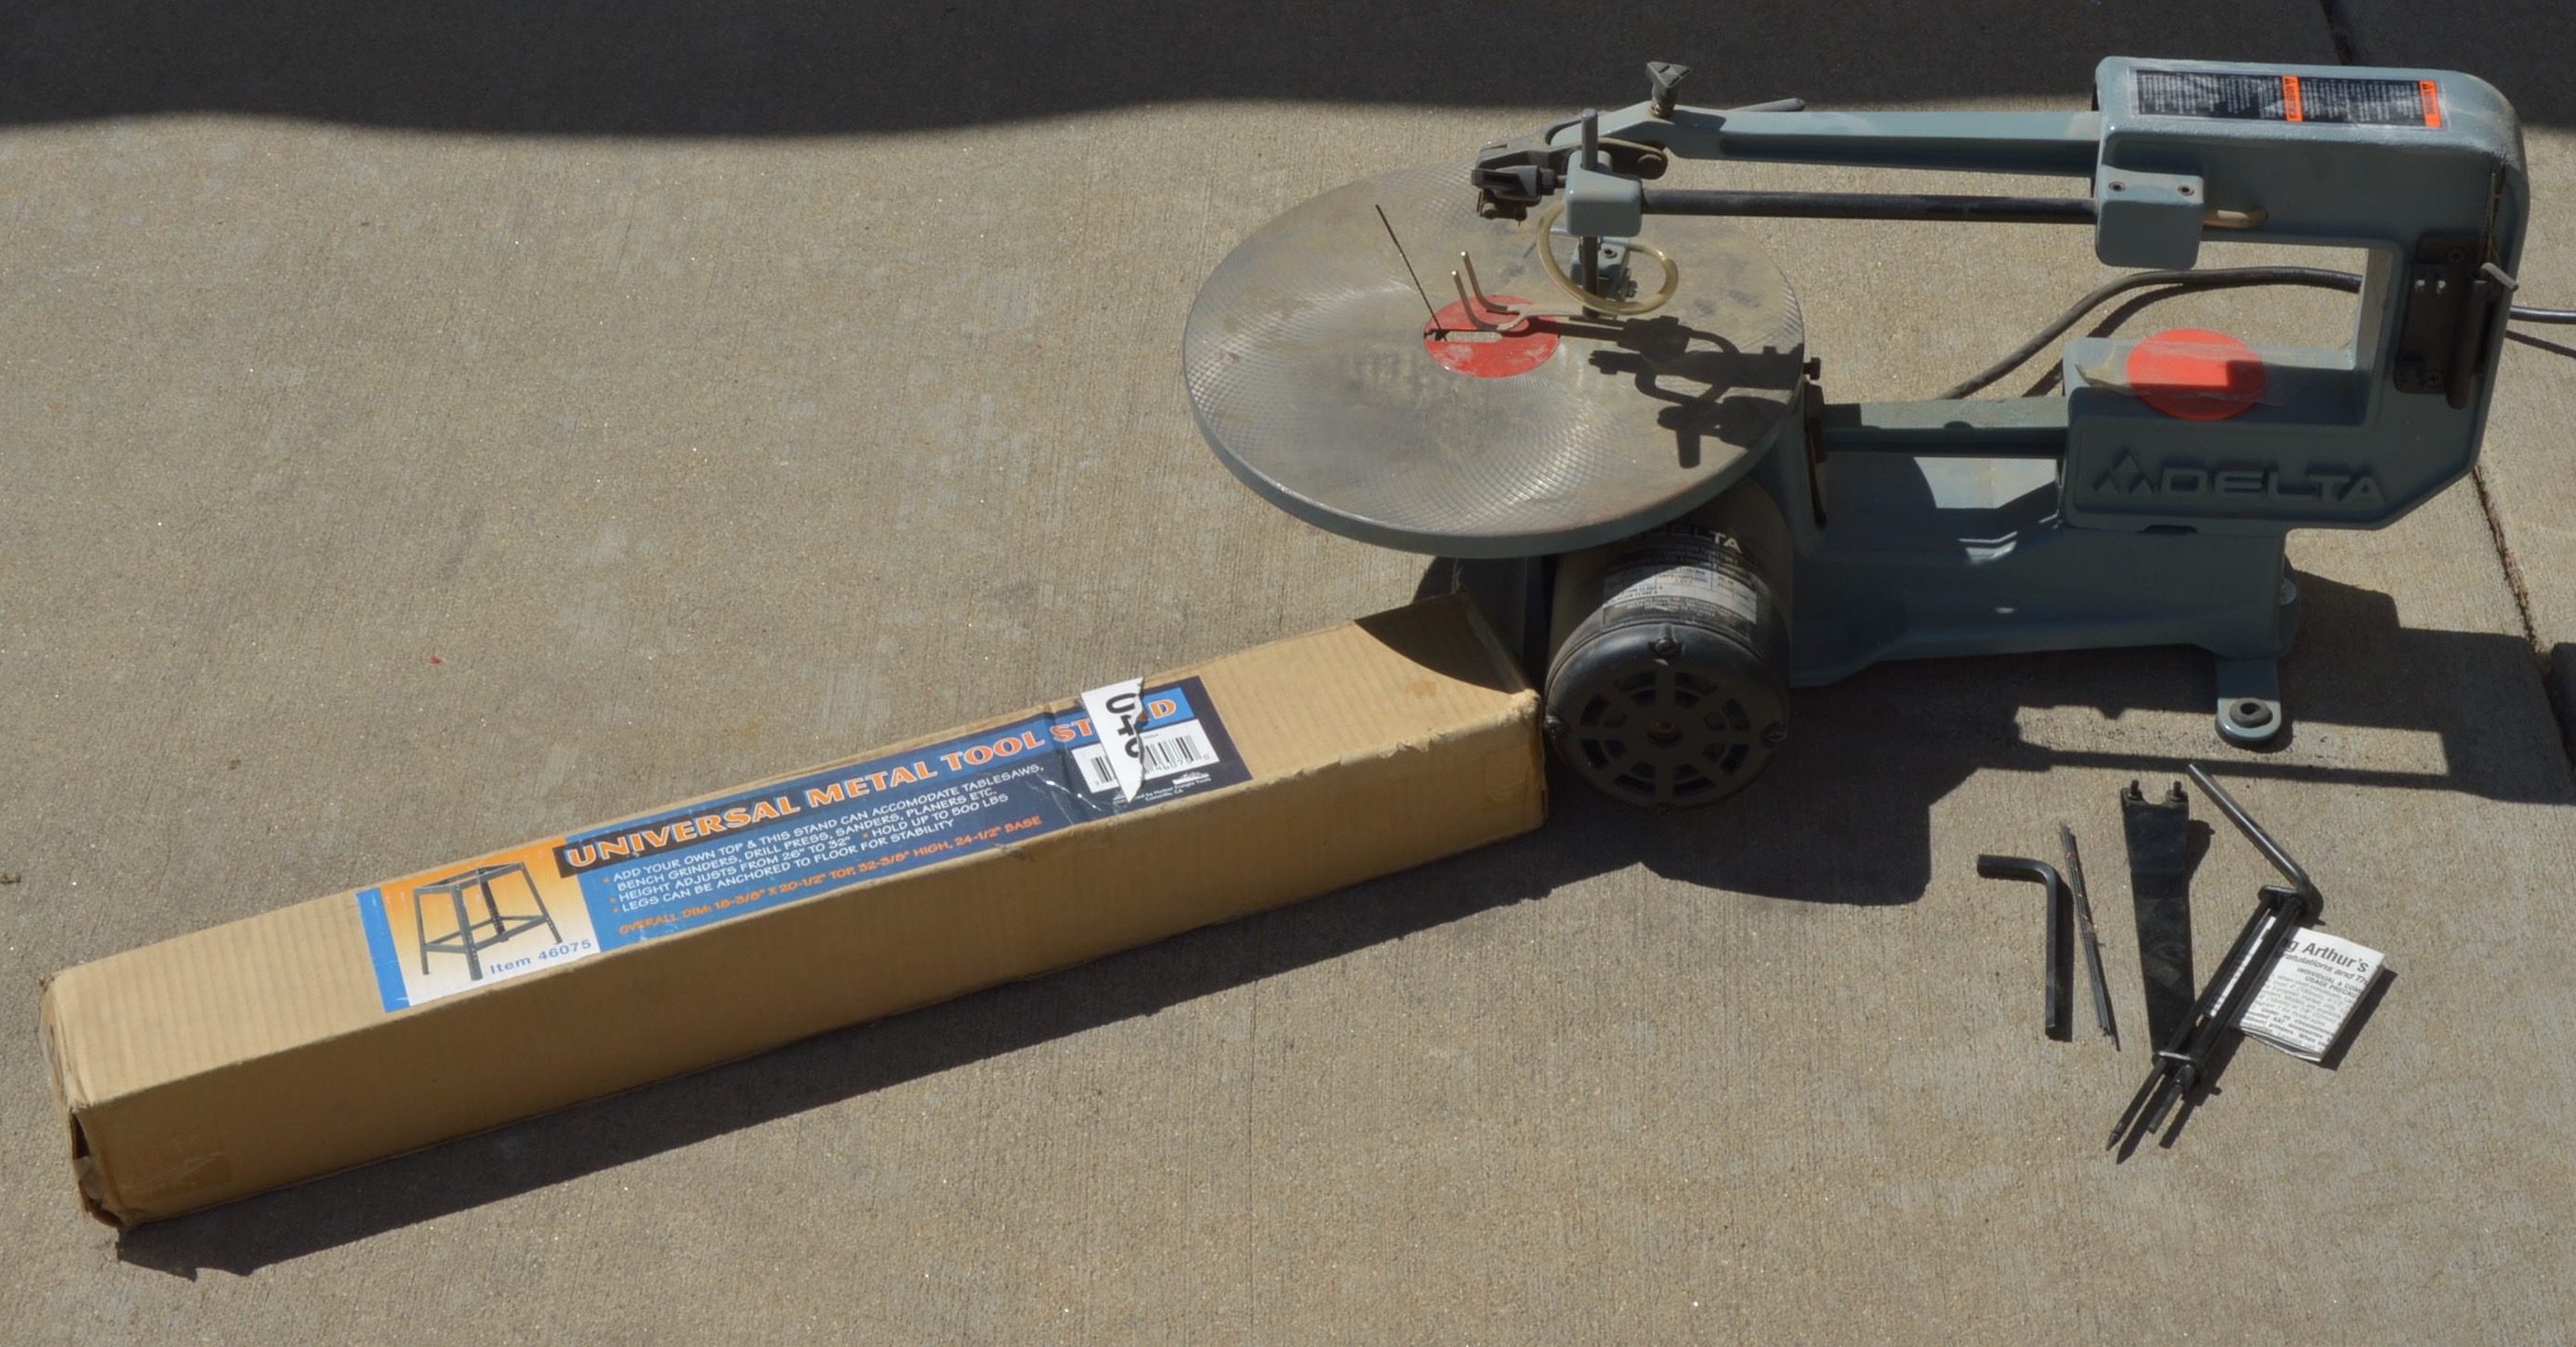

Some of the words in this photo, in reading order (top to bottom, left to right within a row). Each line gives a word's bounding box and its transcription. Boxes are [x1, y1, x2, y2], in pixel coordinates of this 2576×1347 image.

[2159, 462, 2383, 502] DELTA
[565, 795, 800, 867] UNIVERSAL
[805, 761, 938, 809] METAL
[941, 731, 1045, 773] TOOL
[1050, 699, 1176, 742] STD
[613, 867, 640, 881] ADD
[643, 859, 681, 873] YOUR
[684, 851, 715, 865] OWN
[718, 843, 743, 855] TOP
[747, 839, 756, 849] &
[759, 831, 790, 844] THIS
[794, 819, 837, 837] STAND
[841, 810, 868, 824] CAN
[872, 787, 959, 817] ACCOMODATE
[961, 764, 1044, 792] TABLESAWS,
[617, 874, 665, 892] BENCH
[669, 855, 742, 880] GRINDERS,
[744, 844, 781, 860] DRILL
[784, 832, 833, 851] PRESS,
[836, 813, 904, 837] SANDERS,
[906, 795, 967, 818] PLANERS
[970, 787, 997, 801] ETC.
[619, 883, 670, 902] HEIGHT
[675, 867, 737, 889] ADJUSTS
[741, 856, 779, 872] FROM
[782, 849, 805, 861] 26"
[809, 842, 825, 853] TO
[828, 837, 850, 849] 32"
[871, 822, 908, 837] HOLD
[912, 815, 928, 826] UP
[933, 810, 948, 822] TO
[952, 802, 979, 816] 500
[983, 794, 1008, 808] LBS
[619, 913, 679, 935] OVERALL
[913, 841, 953, 857] HIGH,
[1004, 815, 1043, 833] BASE
[622, 897, 659, 912] LEGS
[663, 888, 691, 902] CAN
[695, 883, 712, 895] BE
[716, 862, 790, 889] ANCHORED
[794, 857, 811, 867] TO
[814, 845, 858, 863] FLOOR
[860, 837, 887, 852] FOR
[890, 819, 954, 843] STABILITY
[489, 957, 531, 974] Item
[538, 939, 591, 960] 46075
[2283, 952, 2333, 973] ratulations
[2334, 968, 2354, 981] and
[2302, 942, 2369, 974] Arthur's
[2344, 983, 2362, 994] COM
[2329, 984, 2360, 998] PRECAU
